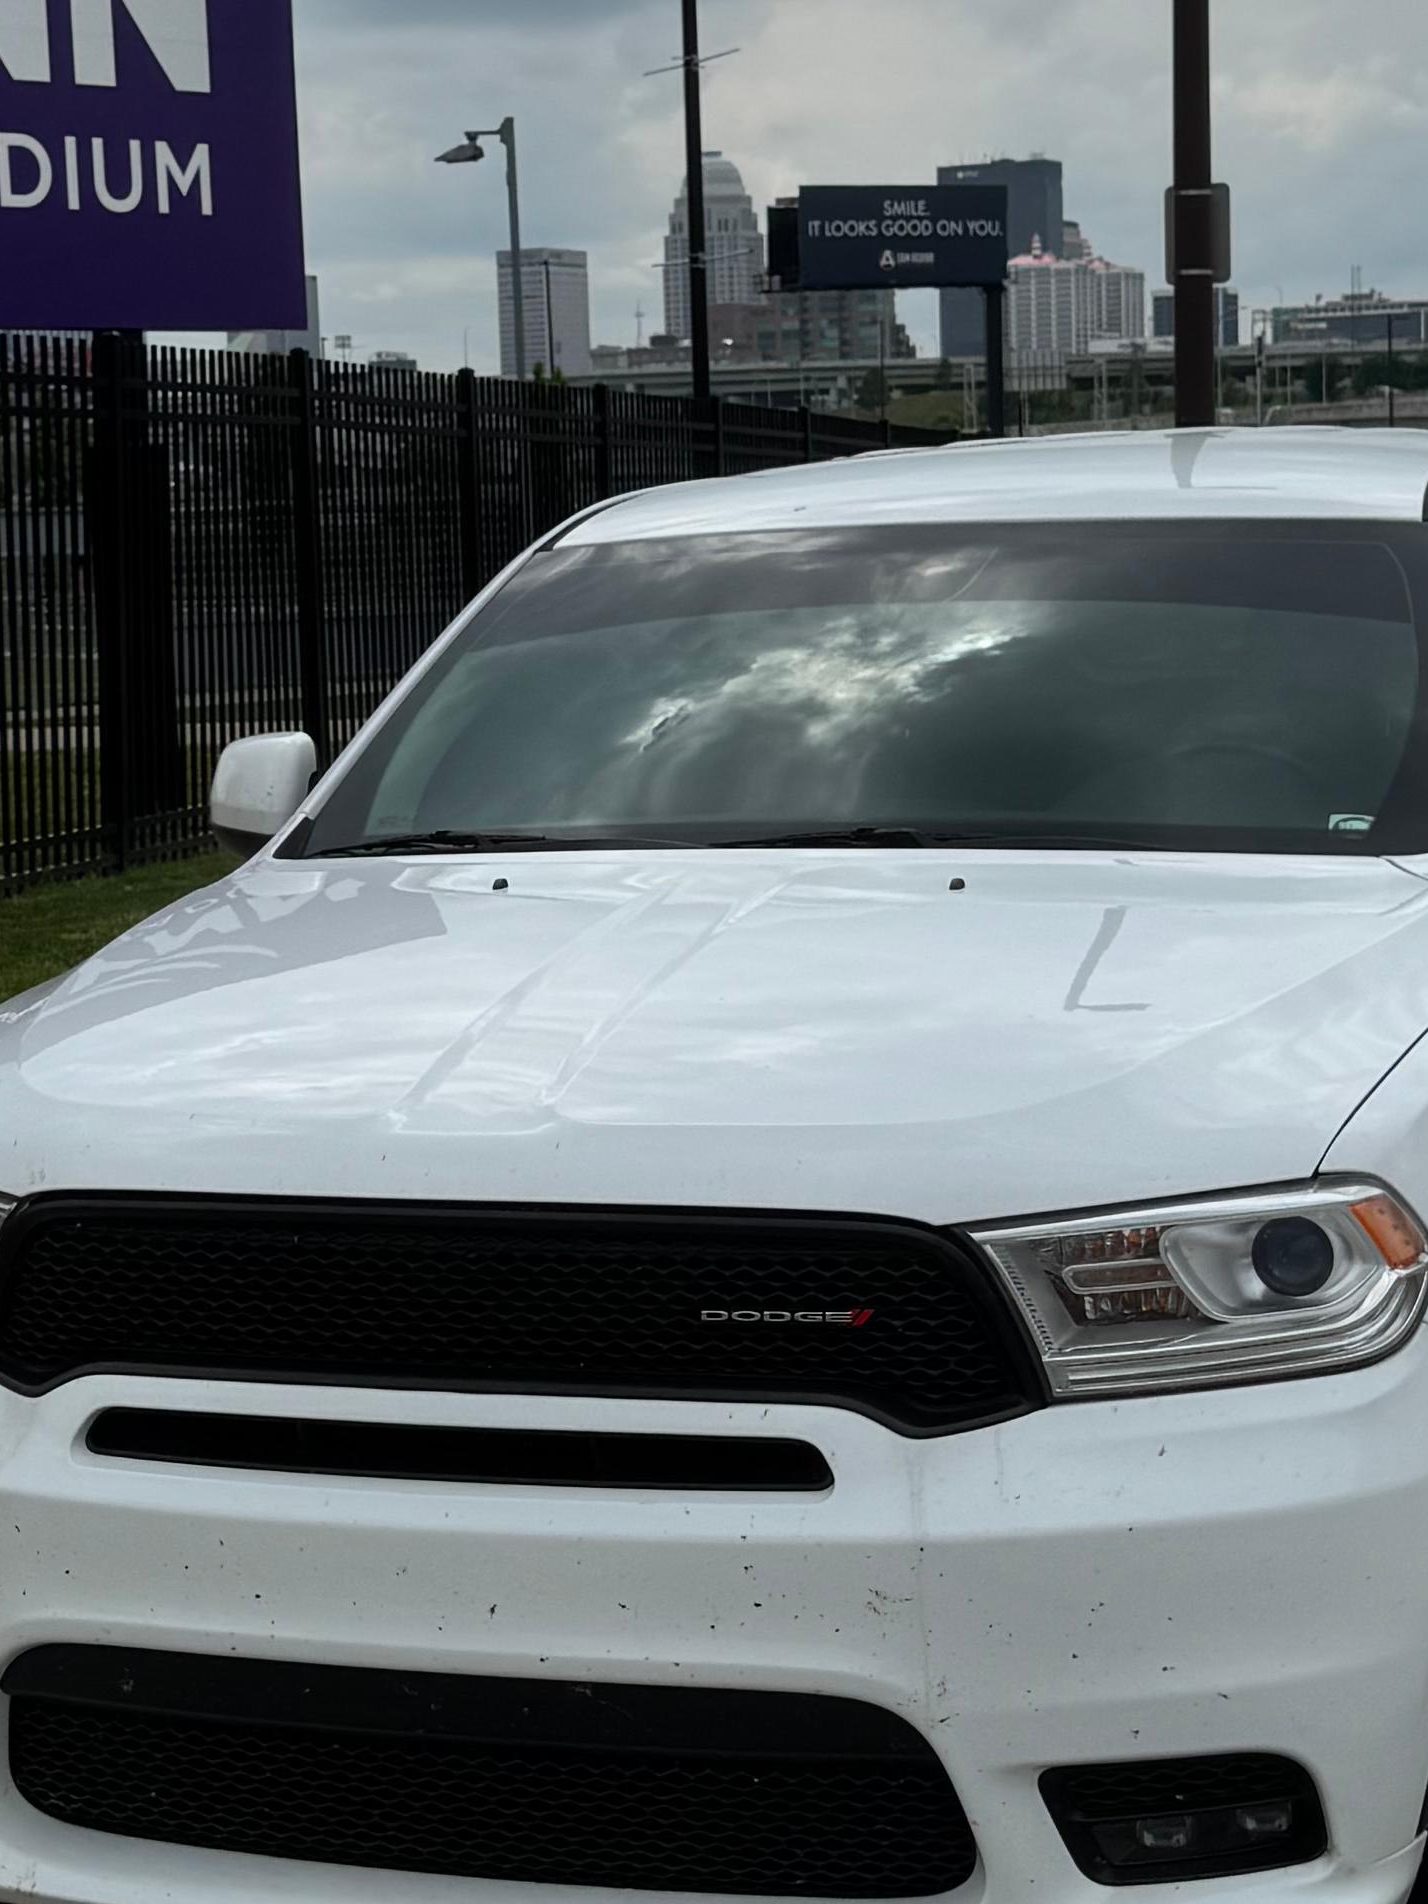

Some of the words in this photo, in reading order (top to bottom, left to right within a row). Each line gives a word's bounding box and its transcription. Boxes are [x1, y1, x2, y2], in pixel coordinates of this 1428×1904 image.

[883, 199, 931, 216] SMILE.
[807, 219, 821, 237] IT
[824, 219, 878, 237] LOOKS
[880, 219, 932, 237] GOOD
[935, 219, 963, 237] ON
[966, 219, 1004, 237] YOU.
[700, 1309, 855, 1323] DODGE
